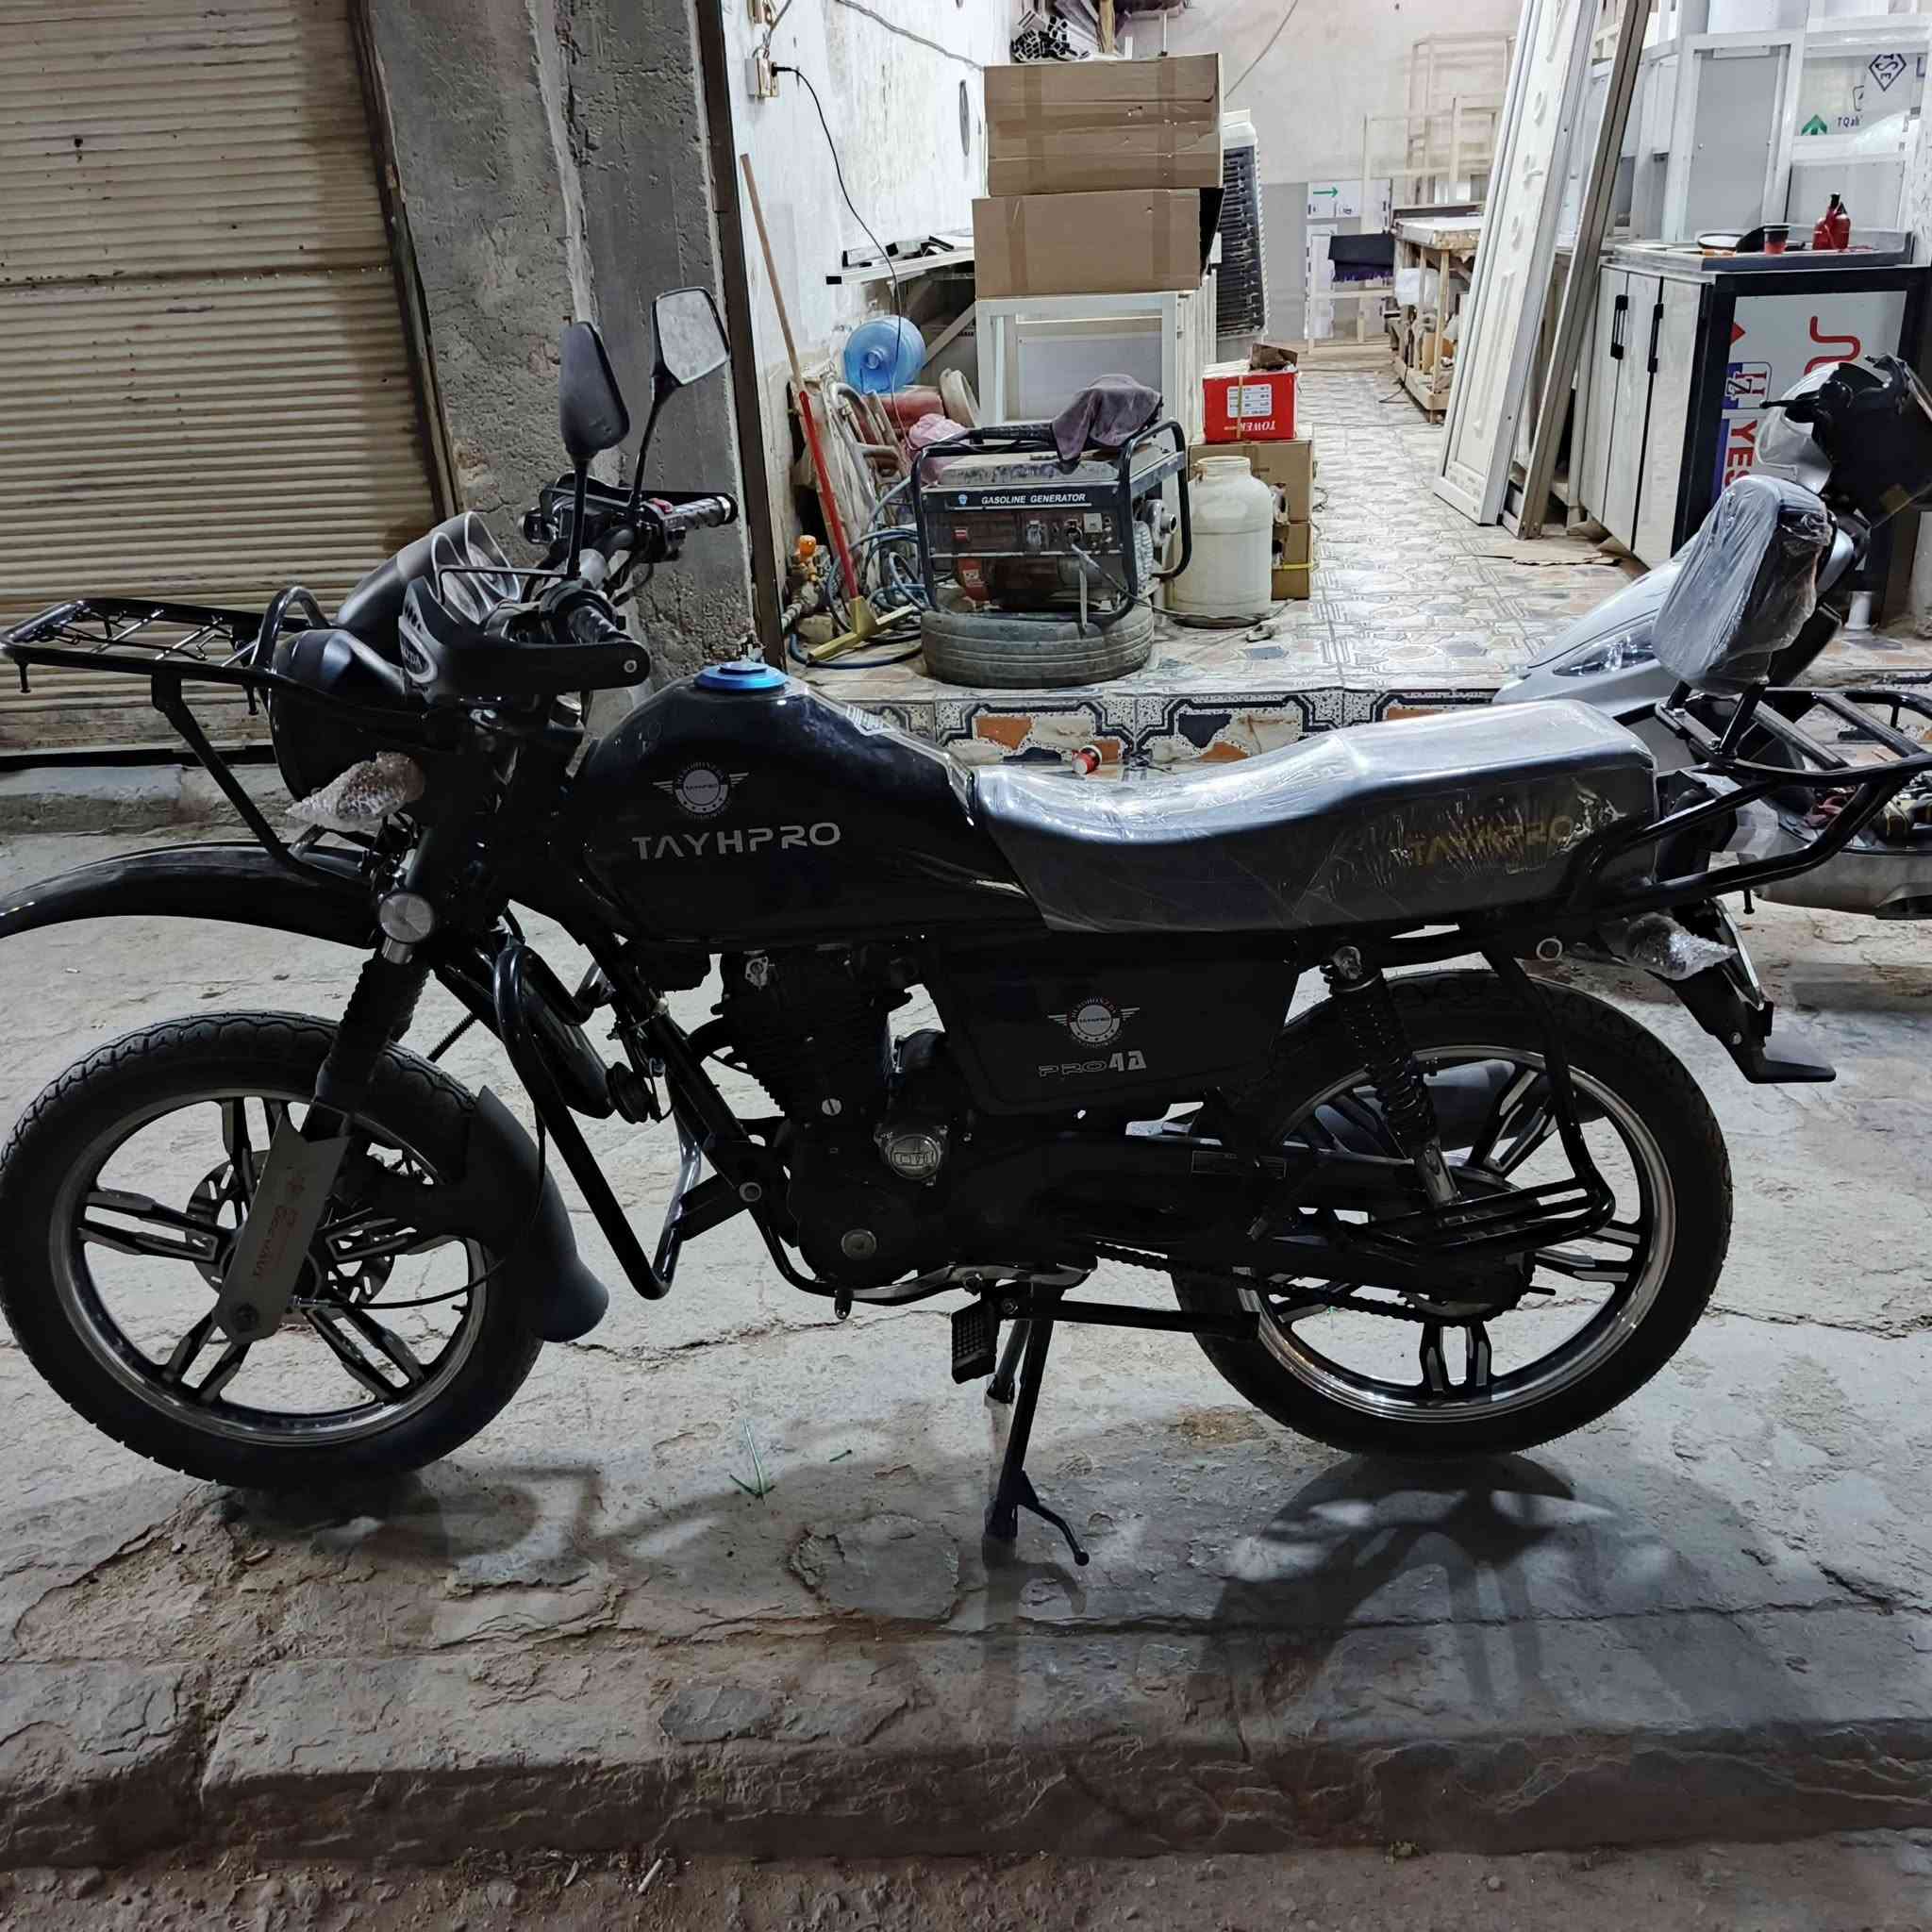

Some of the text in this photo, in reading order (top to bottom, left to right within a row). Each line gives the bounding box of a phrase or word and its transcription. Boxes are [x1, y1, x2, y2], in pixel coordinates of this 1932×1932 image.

[981, 493, 1086, 505] GASOLINE GENERATOR
[631, 822, 841, 860] TAYHPRO
